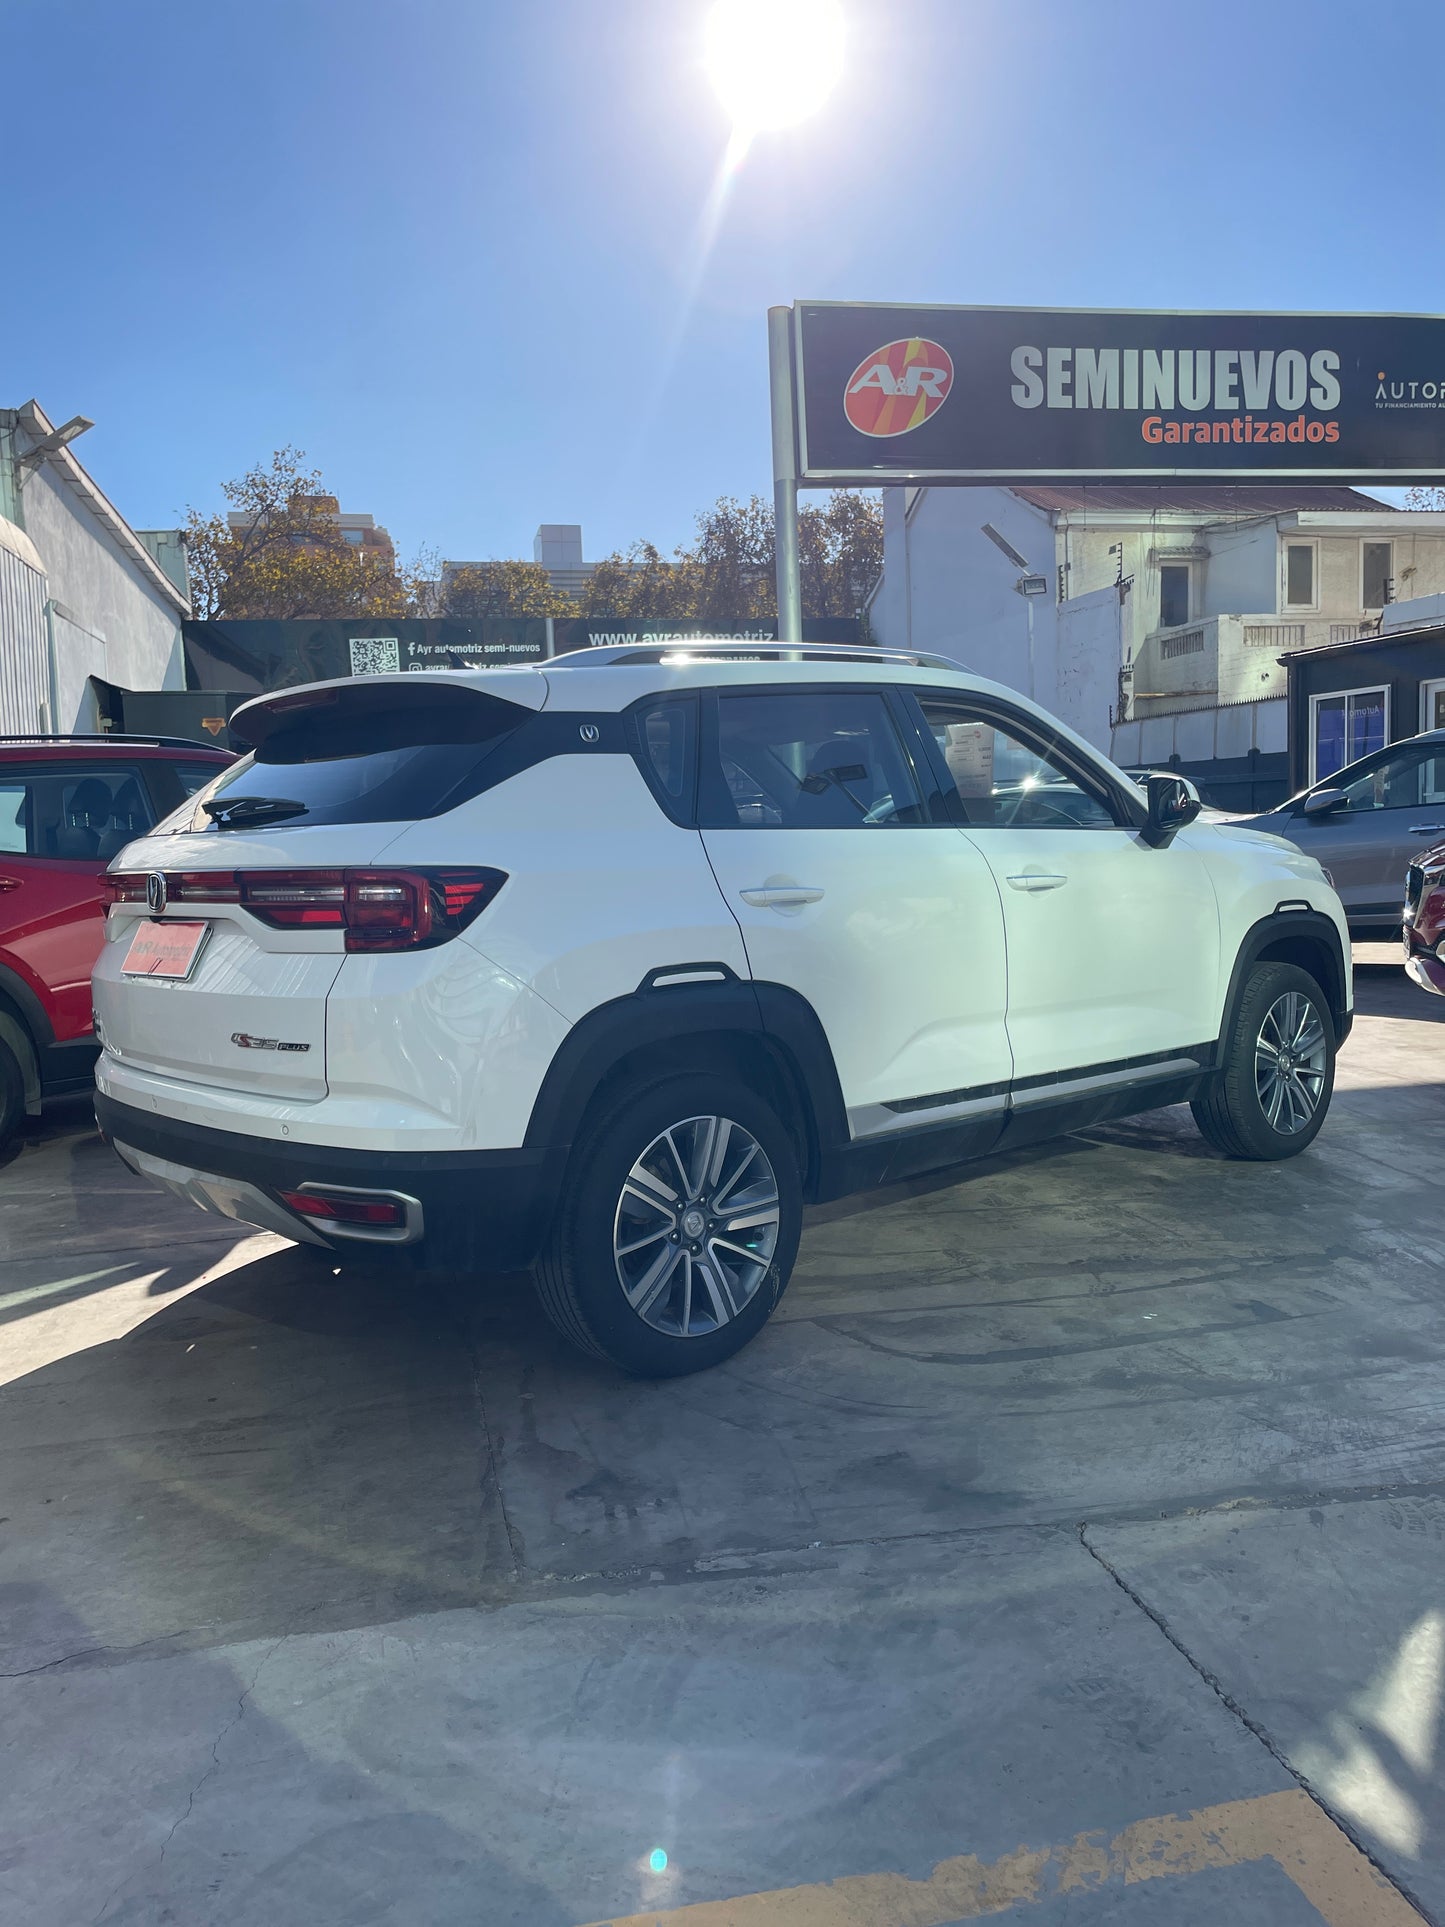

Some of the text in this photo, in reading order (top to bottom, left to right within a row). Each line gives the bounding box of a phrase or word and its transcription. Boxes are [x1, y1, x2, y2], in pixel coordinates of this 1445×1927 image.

[1010, 346, 1341, 411] SEMINUEVOS
[1141, 415, 1340, 443] Garantizados
[417, 644, 432, 655] Ayr
[484, 643, 540, 653] semi-nuevos
[278, 1042, 310, 1052] PLUS
